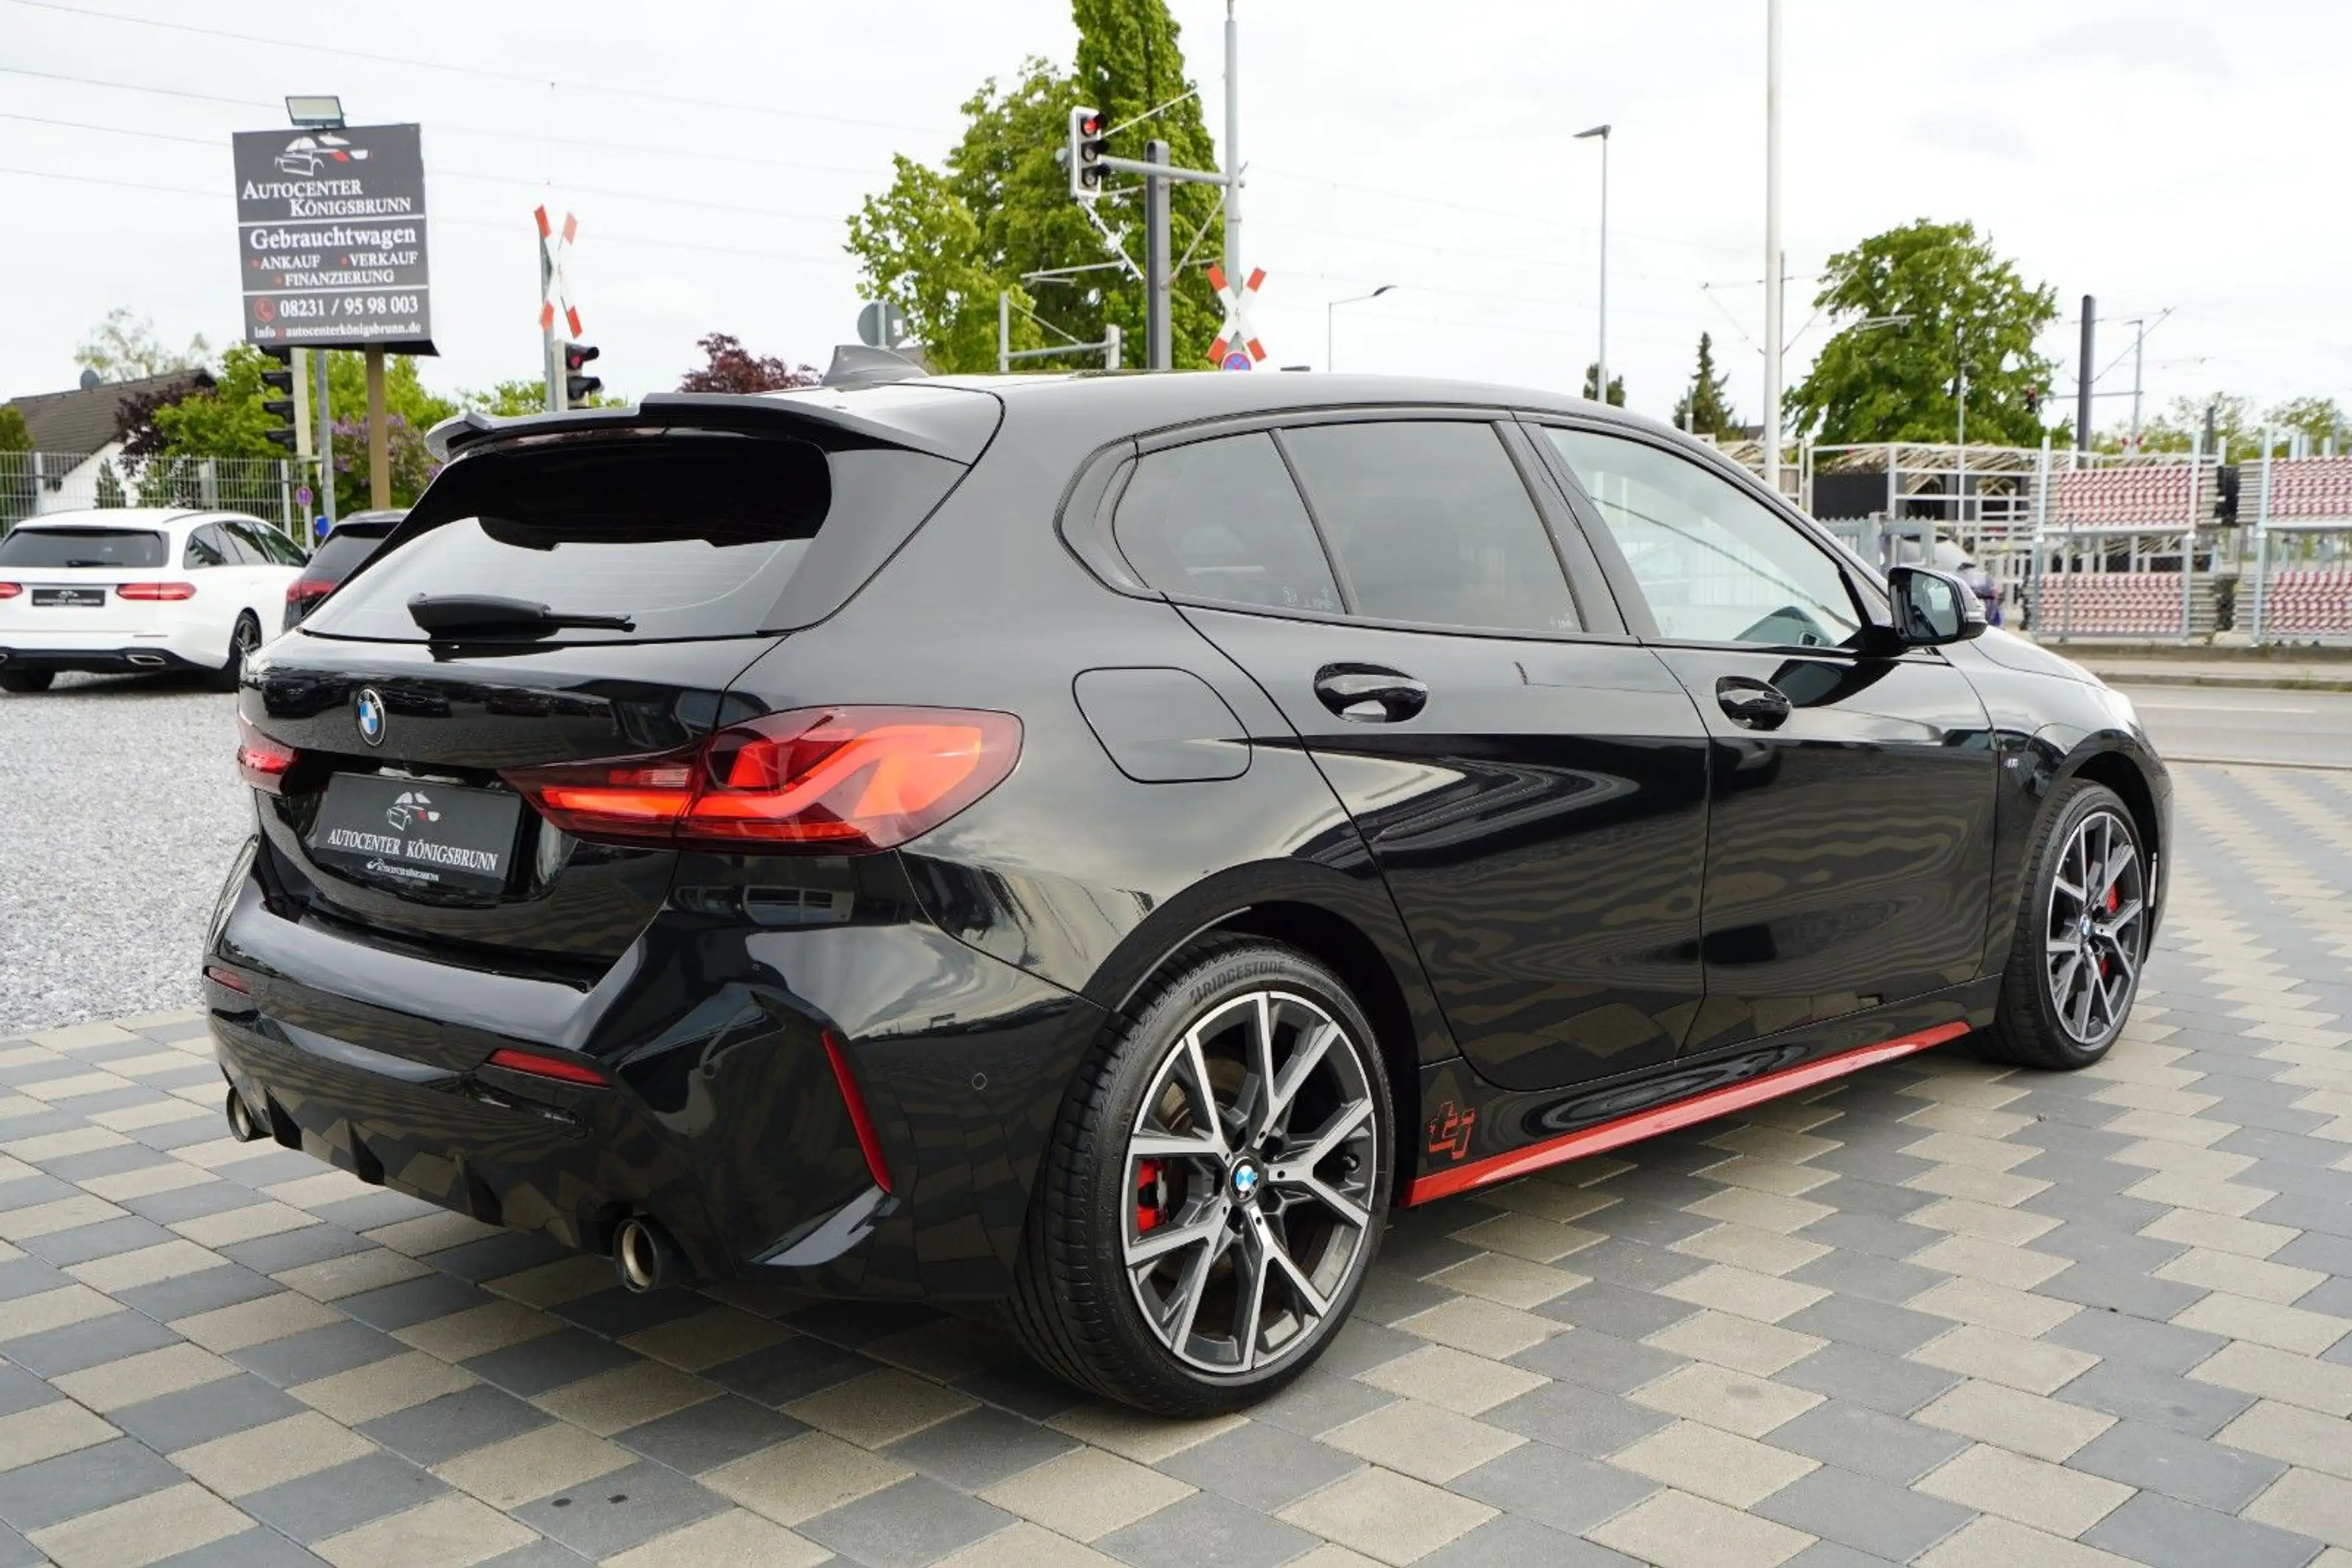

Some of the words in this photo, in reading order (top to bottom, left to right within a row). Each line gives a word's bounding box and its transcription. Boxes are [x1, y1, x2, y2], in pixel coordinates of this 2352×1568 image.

[242, 179, 363, 200] AUTOCENTER
[290, 197, 411, 217] KÖNIGSBRUNN
[250, 226, 417, 250] Gebrauchtwagen
[260, 255, 321, 270] ANKAUF
[349, 251, 418, 267] VERKAUF
[284, 269, 394, 287] FINANZIERUNG
[280, 299, 325, 317] 08231
[344, 297, 363, 315] 95
[368, 296, 386, 314] 98
[391, 295, 418, 313] 003
[327, 828, 400, 855] AUTOCENTER
[406, 838, 499, 871] KÖNIGSBRUNN
[1189, 960, 1286, 1005] BRIDGESTONE
